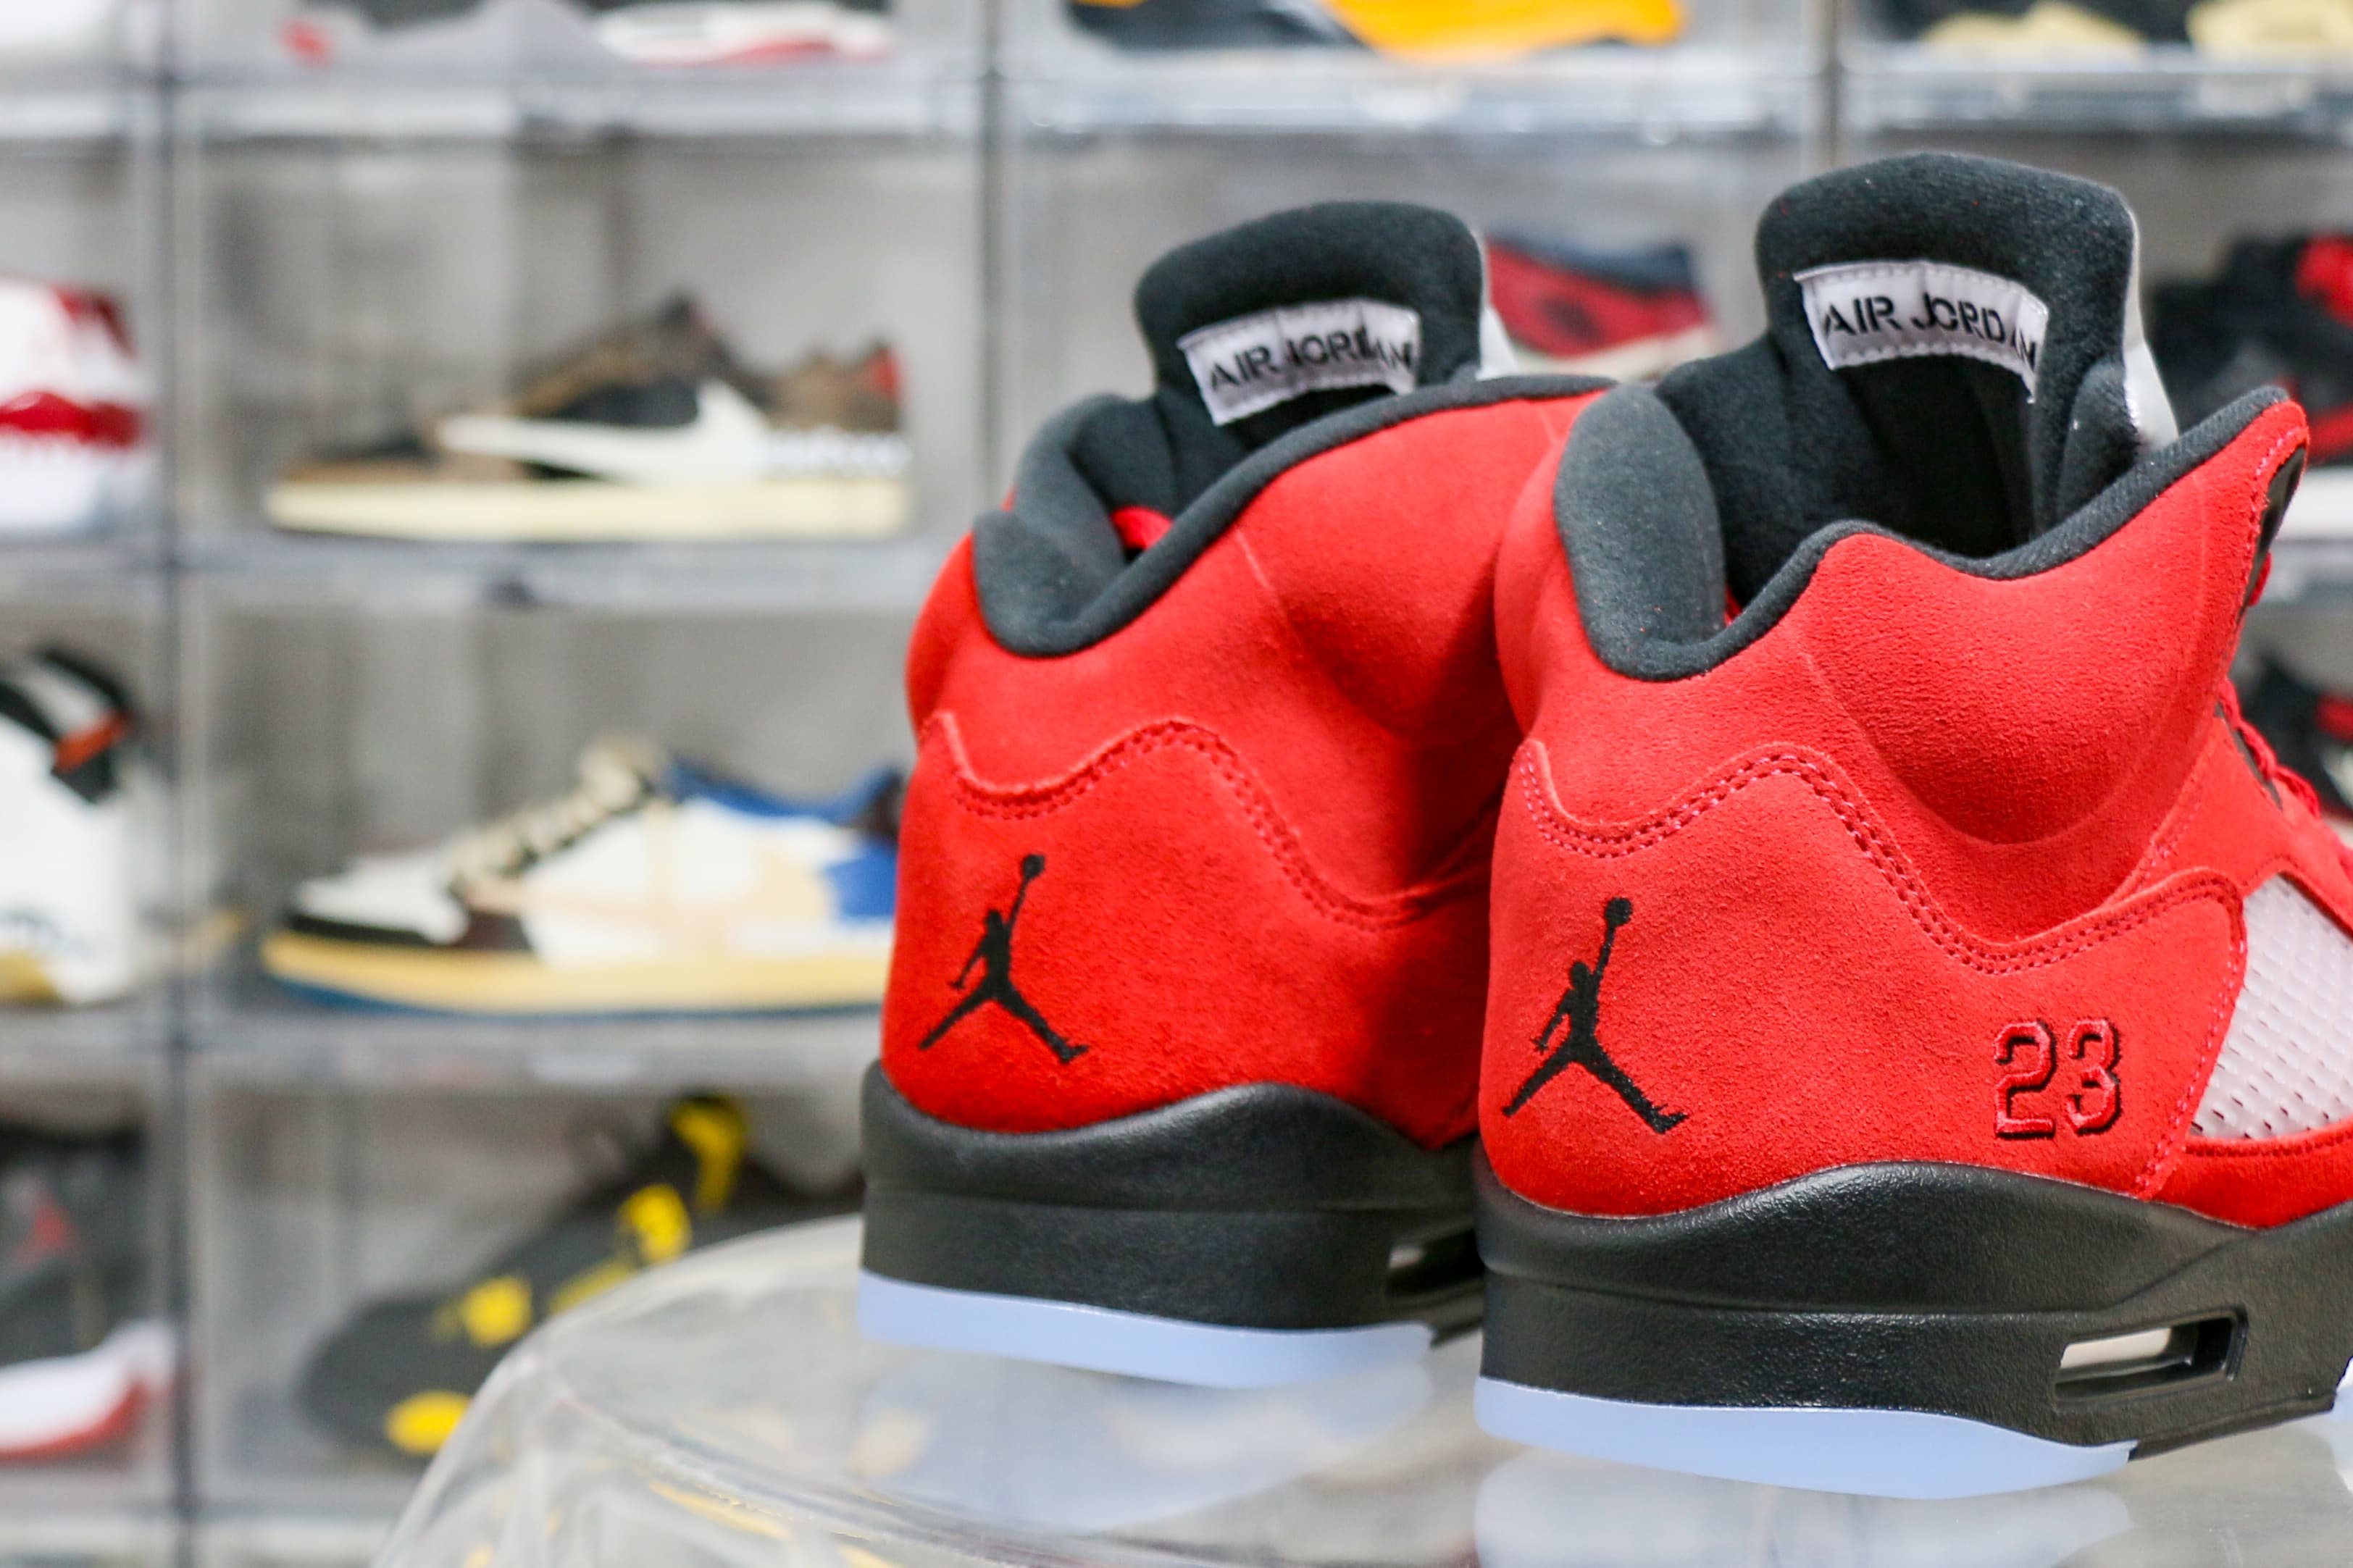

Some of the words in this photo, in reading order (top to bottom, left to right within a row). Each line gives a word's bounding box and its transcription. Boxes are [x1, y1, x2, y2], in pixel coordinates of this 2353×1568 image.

[1823, 295, 1903, 336] AIR
[1209, 345, 1279, 392] AIR
[1994, 1018, 2123, 1140] 23
